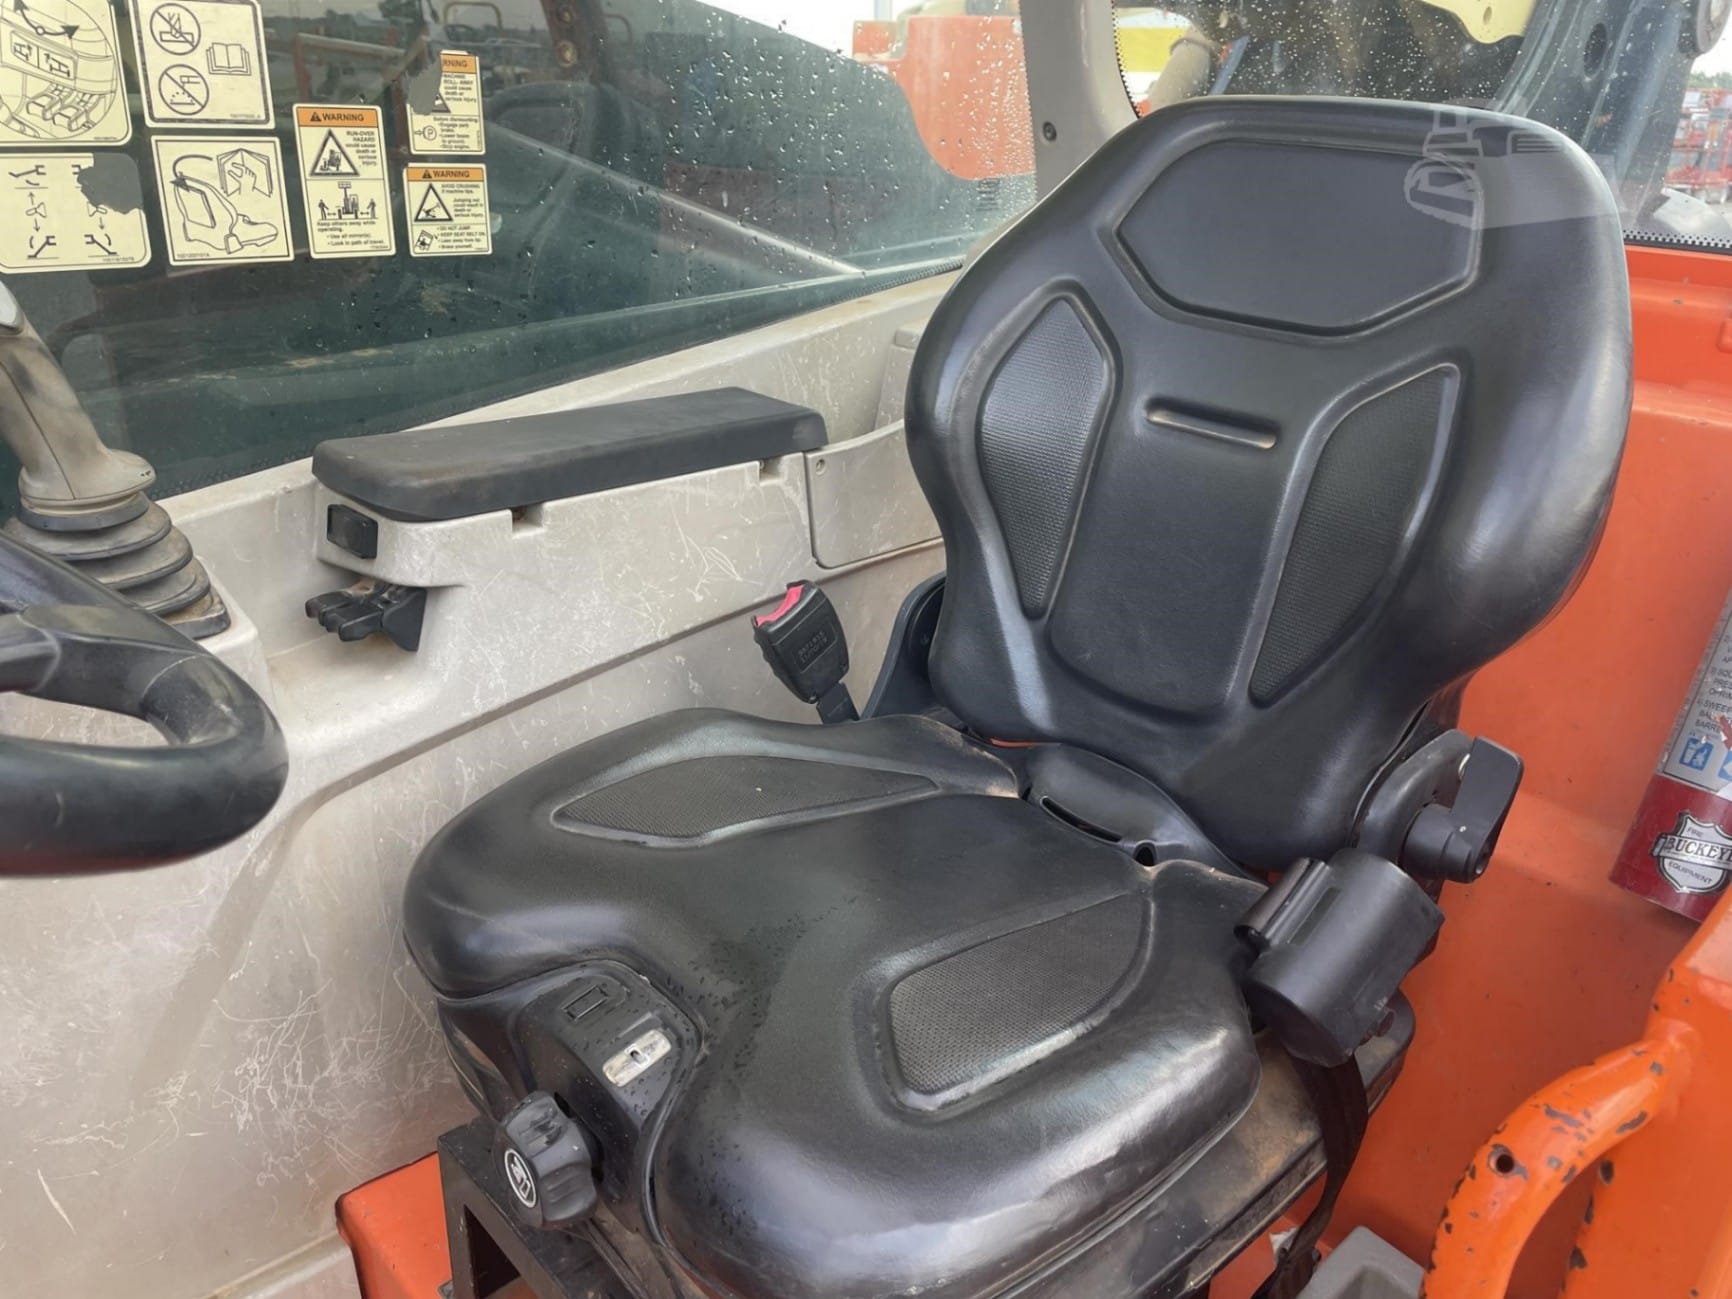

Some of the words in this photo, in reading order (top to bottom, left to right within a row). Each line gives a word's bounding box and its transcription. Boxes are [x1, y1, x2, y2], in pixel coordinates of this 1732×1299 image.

[442, 60, 469, 68] RNING
[322, 113, 365, 122] WARNING
[433, 170, 470, 178] WARNING
[1687, 827, 1704, 838] FIRE
[1669, 861, 1713, 885] EQUIPMENT
